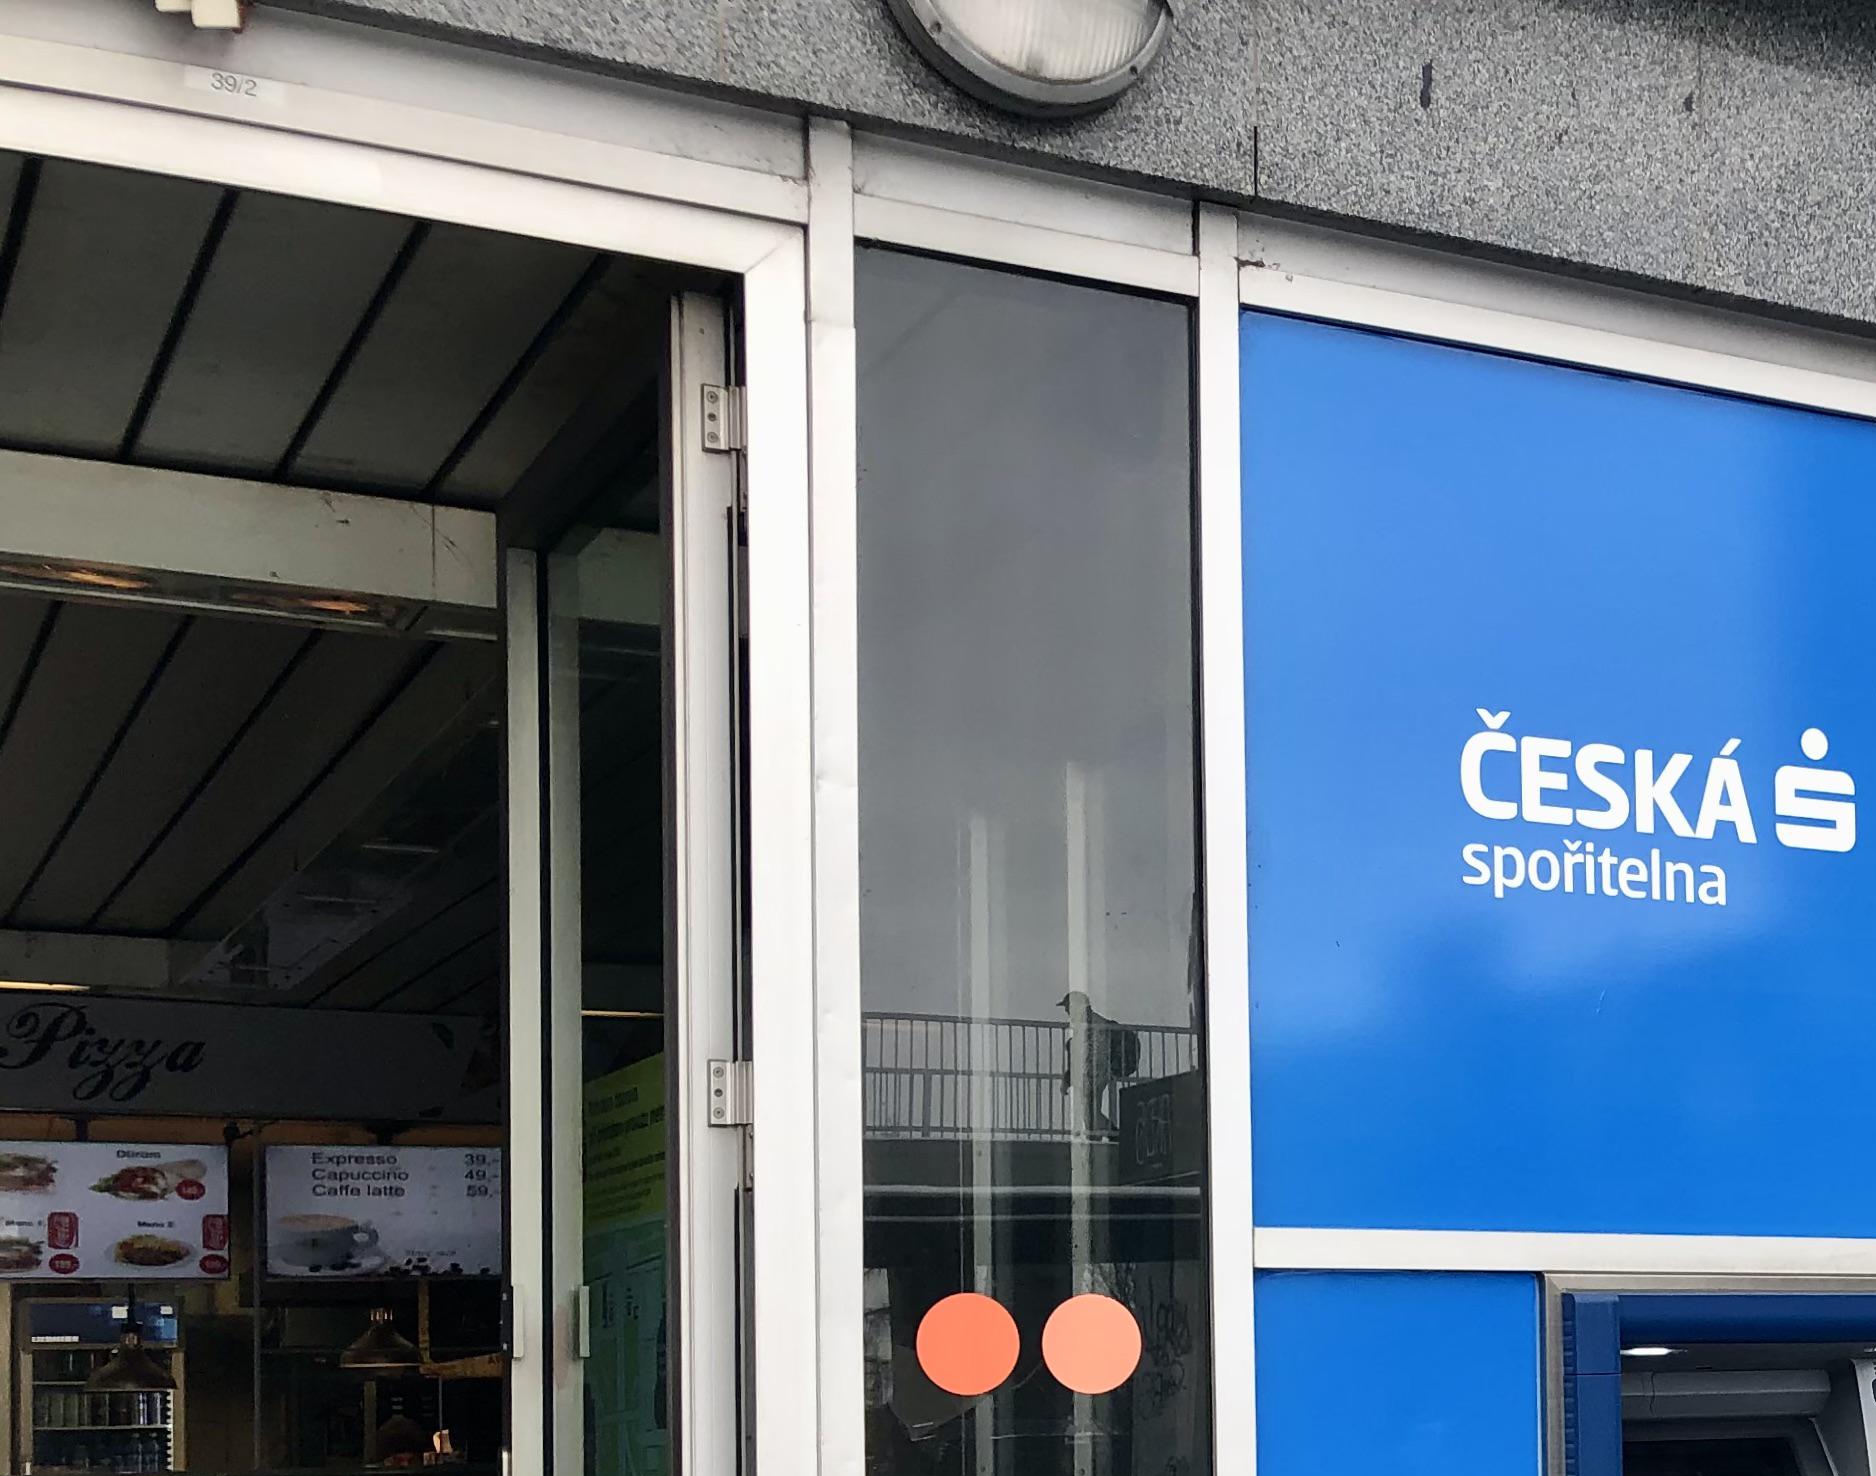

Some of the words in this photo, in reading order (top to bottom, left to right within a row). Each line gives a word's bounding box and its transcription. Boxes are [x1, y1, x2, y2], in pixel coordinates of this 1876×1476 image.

[211, 72, 257, 97] 39/2
[1460, 707, 1757, 844] ČESKÁ
[1461, 838, 1727, 906] spořitelna
[0, 1002, 206, 1101] Pizza
[311, 1152, 397, 1166] Expresso
[311, 1168, 409, 1182] Capuccino
